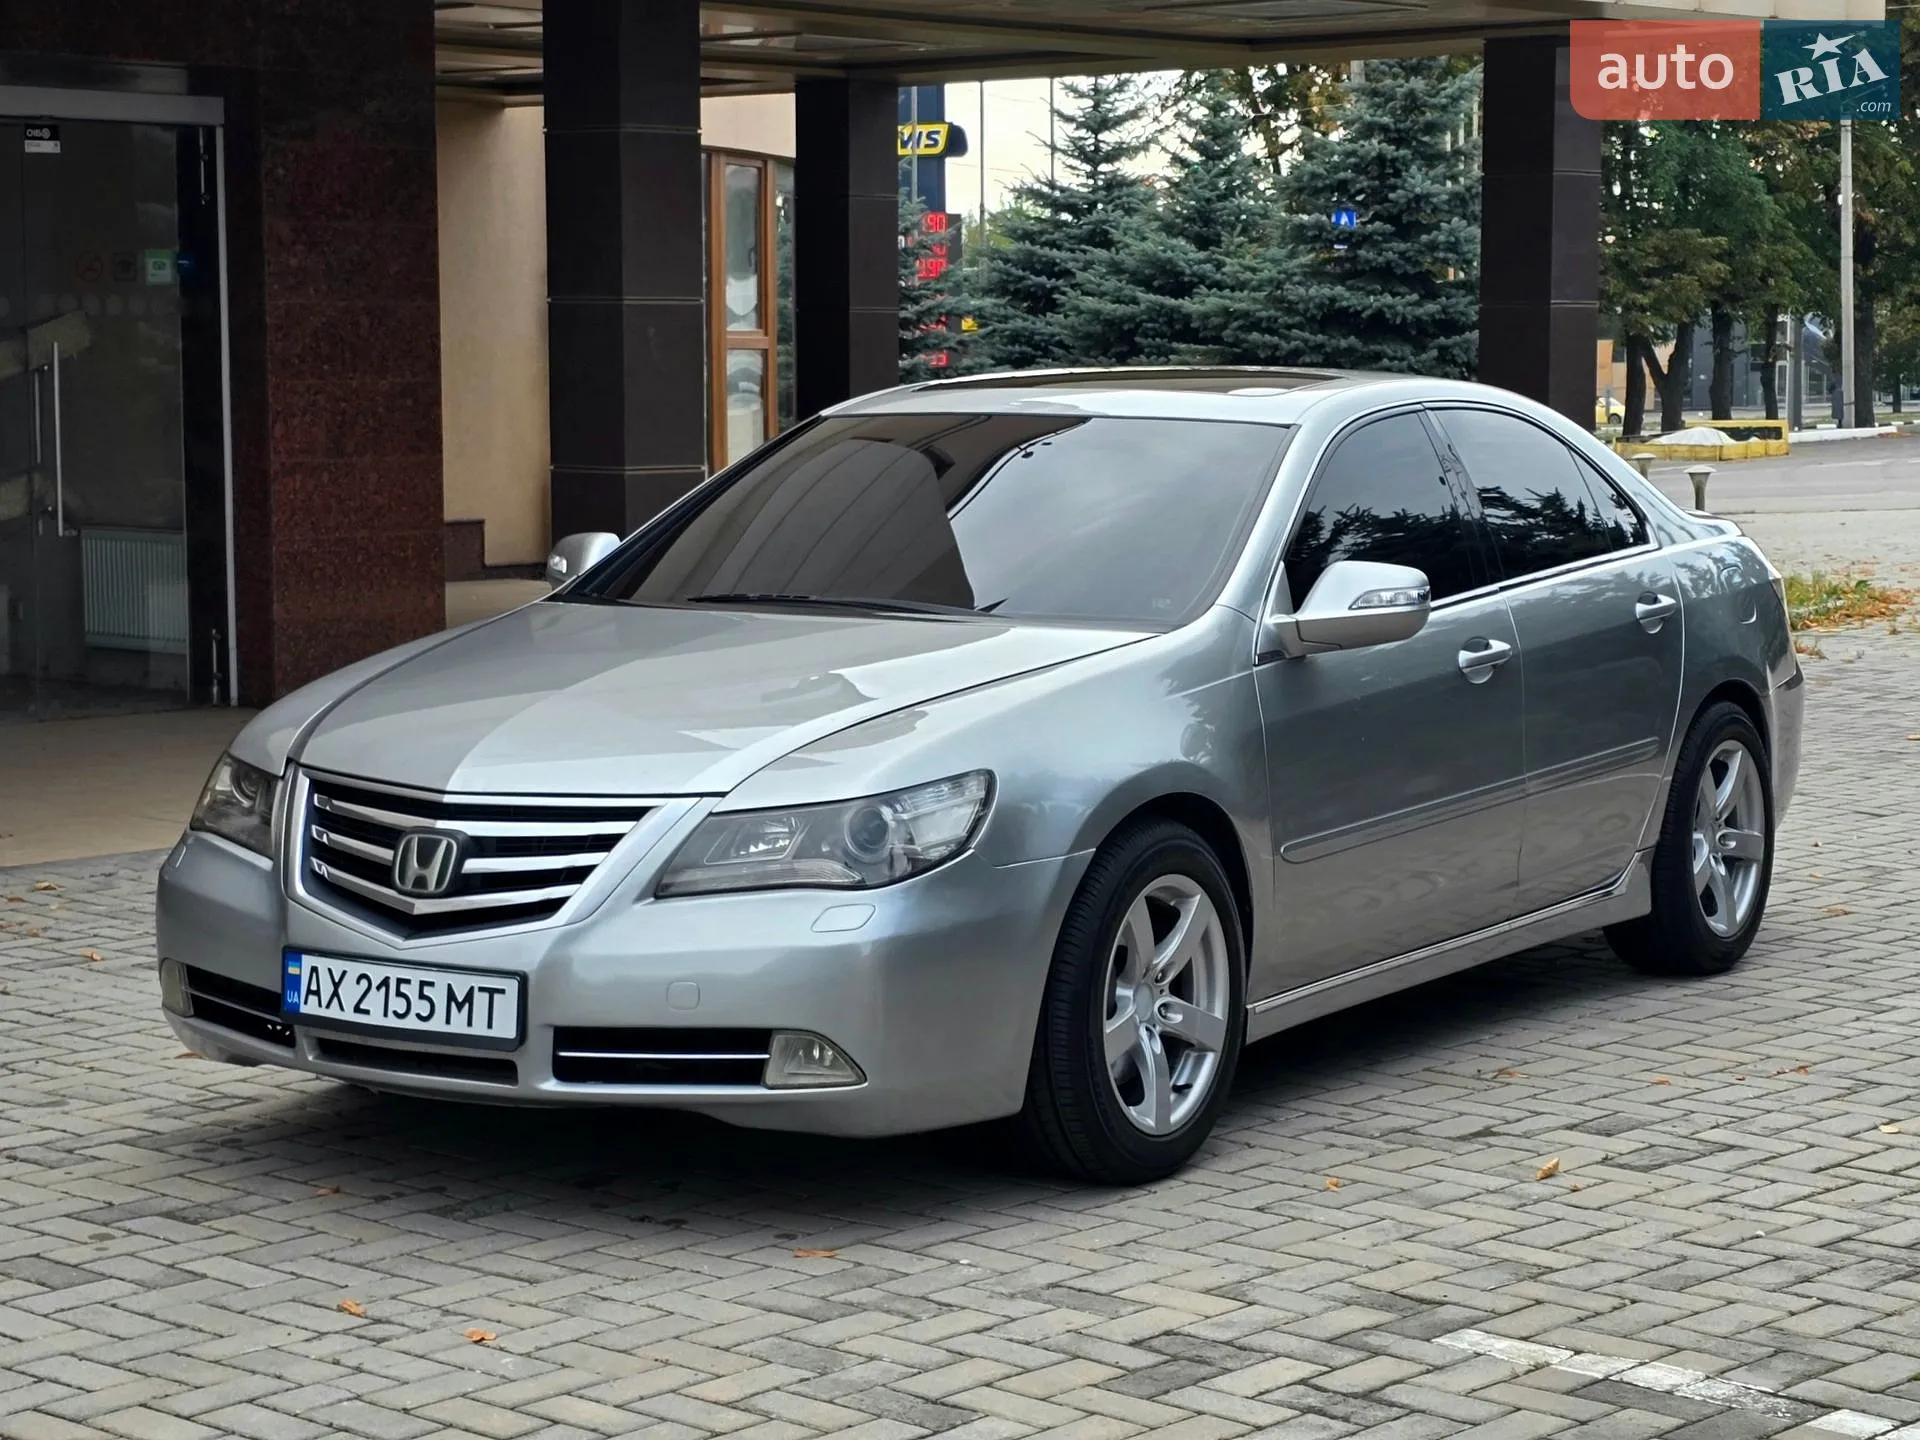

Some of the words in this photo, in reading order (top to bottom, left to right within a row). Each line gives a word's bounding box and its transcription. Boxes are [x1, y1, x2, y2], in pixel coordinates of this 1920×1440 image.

[303, 965, 348, 1012] AX
[353, 972, 436, 1023] 2155
[445, 982, 506, 1030] MT
